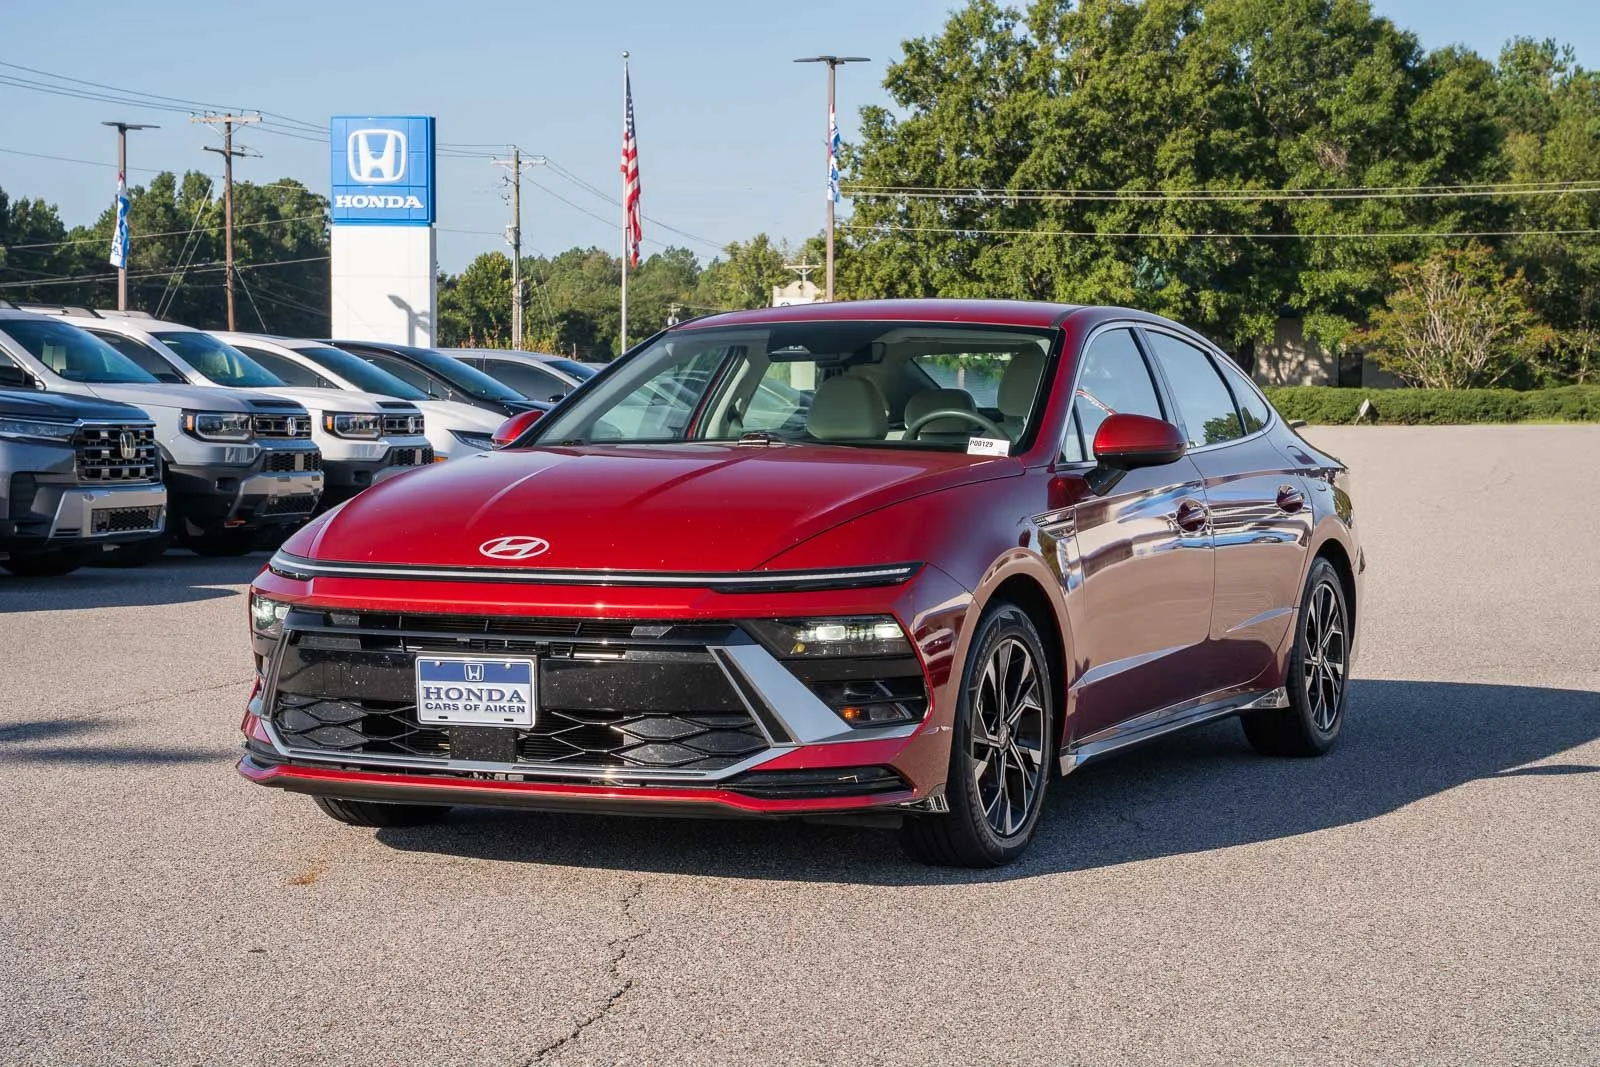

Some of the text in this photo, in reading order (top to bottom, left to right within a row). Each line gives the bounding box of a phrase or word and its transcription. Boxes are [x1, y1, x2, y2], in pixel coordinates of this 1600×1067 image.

[335, 195, 424, 208] HONDA
[423, 686, 526, 703] HONDA
[425, 703, 525, 713] CARS OF AIKEN
